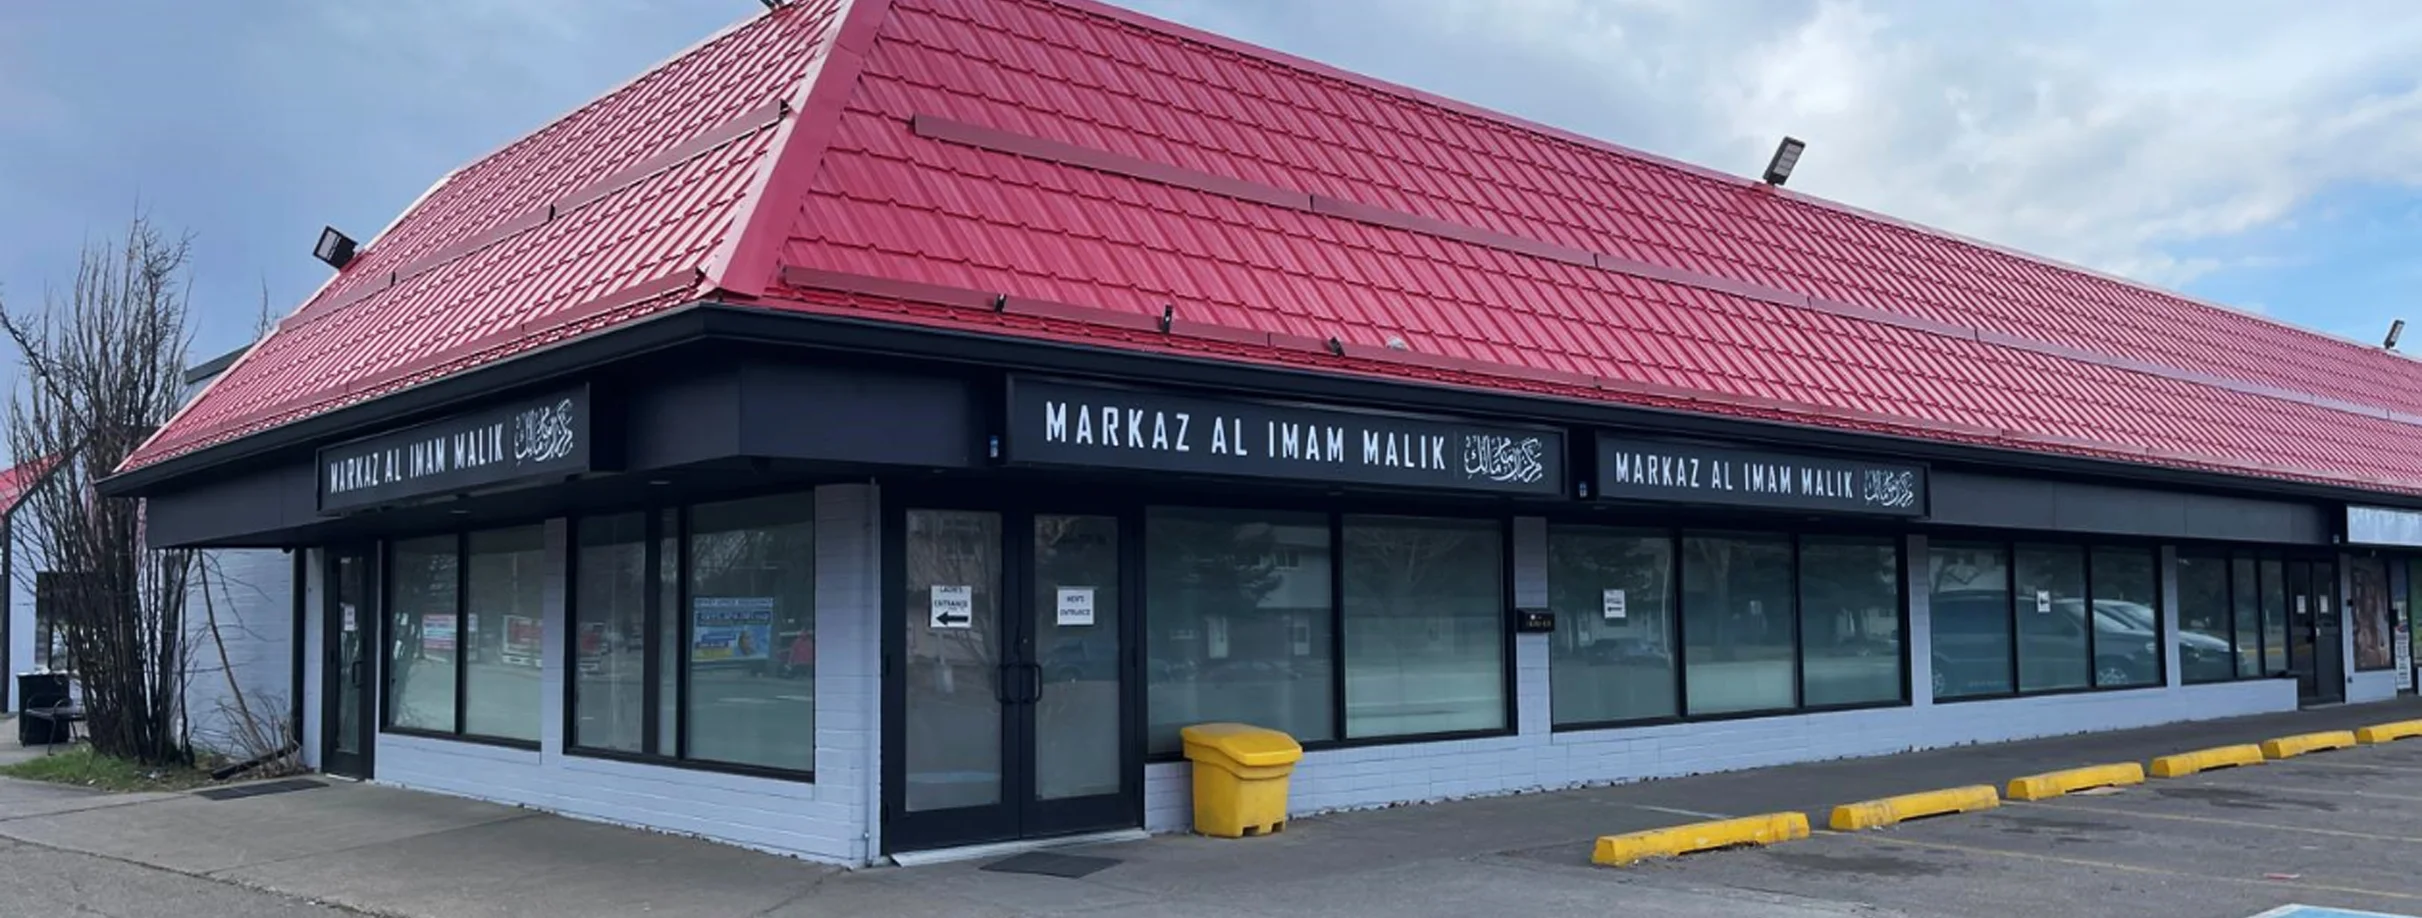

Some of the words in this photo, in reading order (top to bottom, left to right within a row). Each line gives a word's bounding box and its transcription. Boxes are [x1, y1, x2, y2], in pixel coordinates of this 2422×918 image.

[330, 452, 379, 494] MARKAZ
[384, 448, 402, 483] AL
[409, 437, 446, 479] IMAM
[454, 423, 504, 470] MALIK
[1045, 400, 1190, 452] MARKAZ
[1211, 416, 1248, 456] AL
[1268, 420, 1344, 463] IMAM
[1362, 429, 1446, 470] MALIK
[1615, 451, 1701, 488] MARKAZ
[1711, 460, 1734, 491] AL
[1744, 462, 1792, 495] IMAM
[1801, 467, 1853, 499] MALIK
